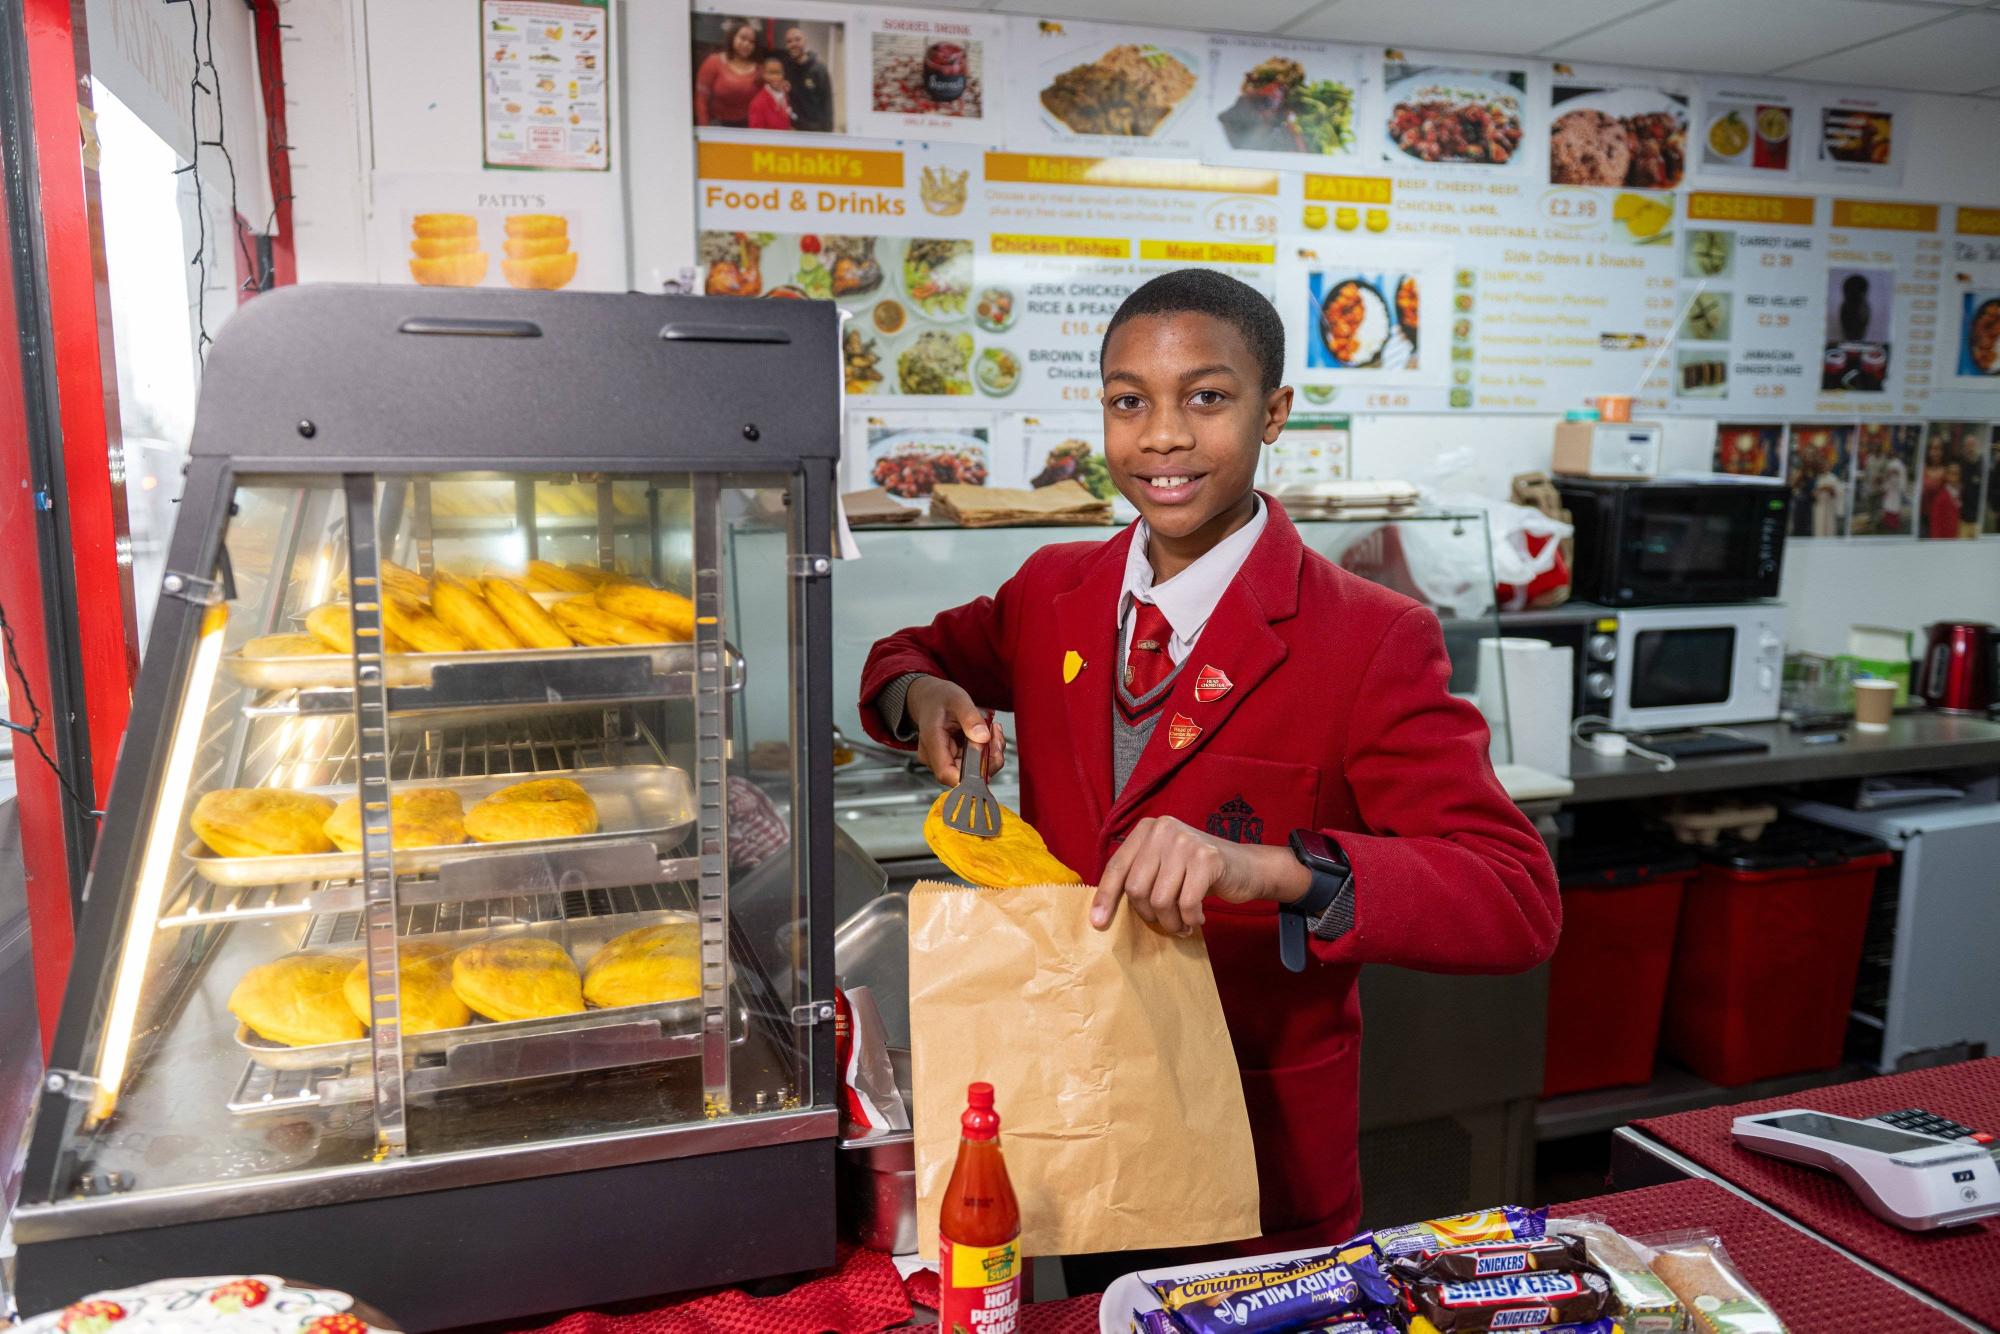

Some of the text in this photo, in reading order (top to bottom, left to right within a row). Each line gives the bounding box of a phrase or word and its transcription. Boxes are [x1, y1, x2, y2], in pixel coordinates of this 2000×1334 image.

[753, 151, 863, 178] Malaki's
[478, 194, 546, 207] PATTY'S
[706, 186, 905, 216] Food & Drinks
[992, 237, 1059, 254] Chicken
[1065, 240, 1120, 257] Dishes
[1210, 246, 1262, 261] Dishes
[1028, 284, 1133, 298] JERK CHICKEN
[1027, 301, 1116, 314] RICE & PEAS
[1029, 349, 1082, 362] BROWN
[1477, 1255, 1524, 1273] SNICKERS
[989, 1266, 1010, 1281] SUN
[1250, 1265, 1352, 1312] DAIRY MILK
[984, 1288, 1011, 1309] HOT
[1493, 1309, 1547, 1327] SNICKERS
